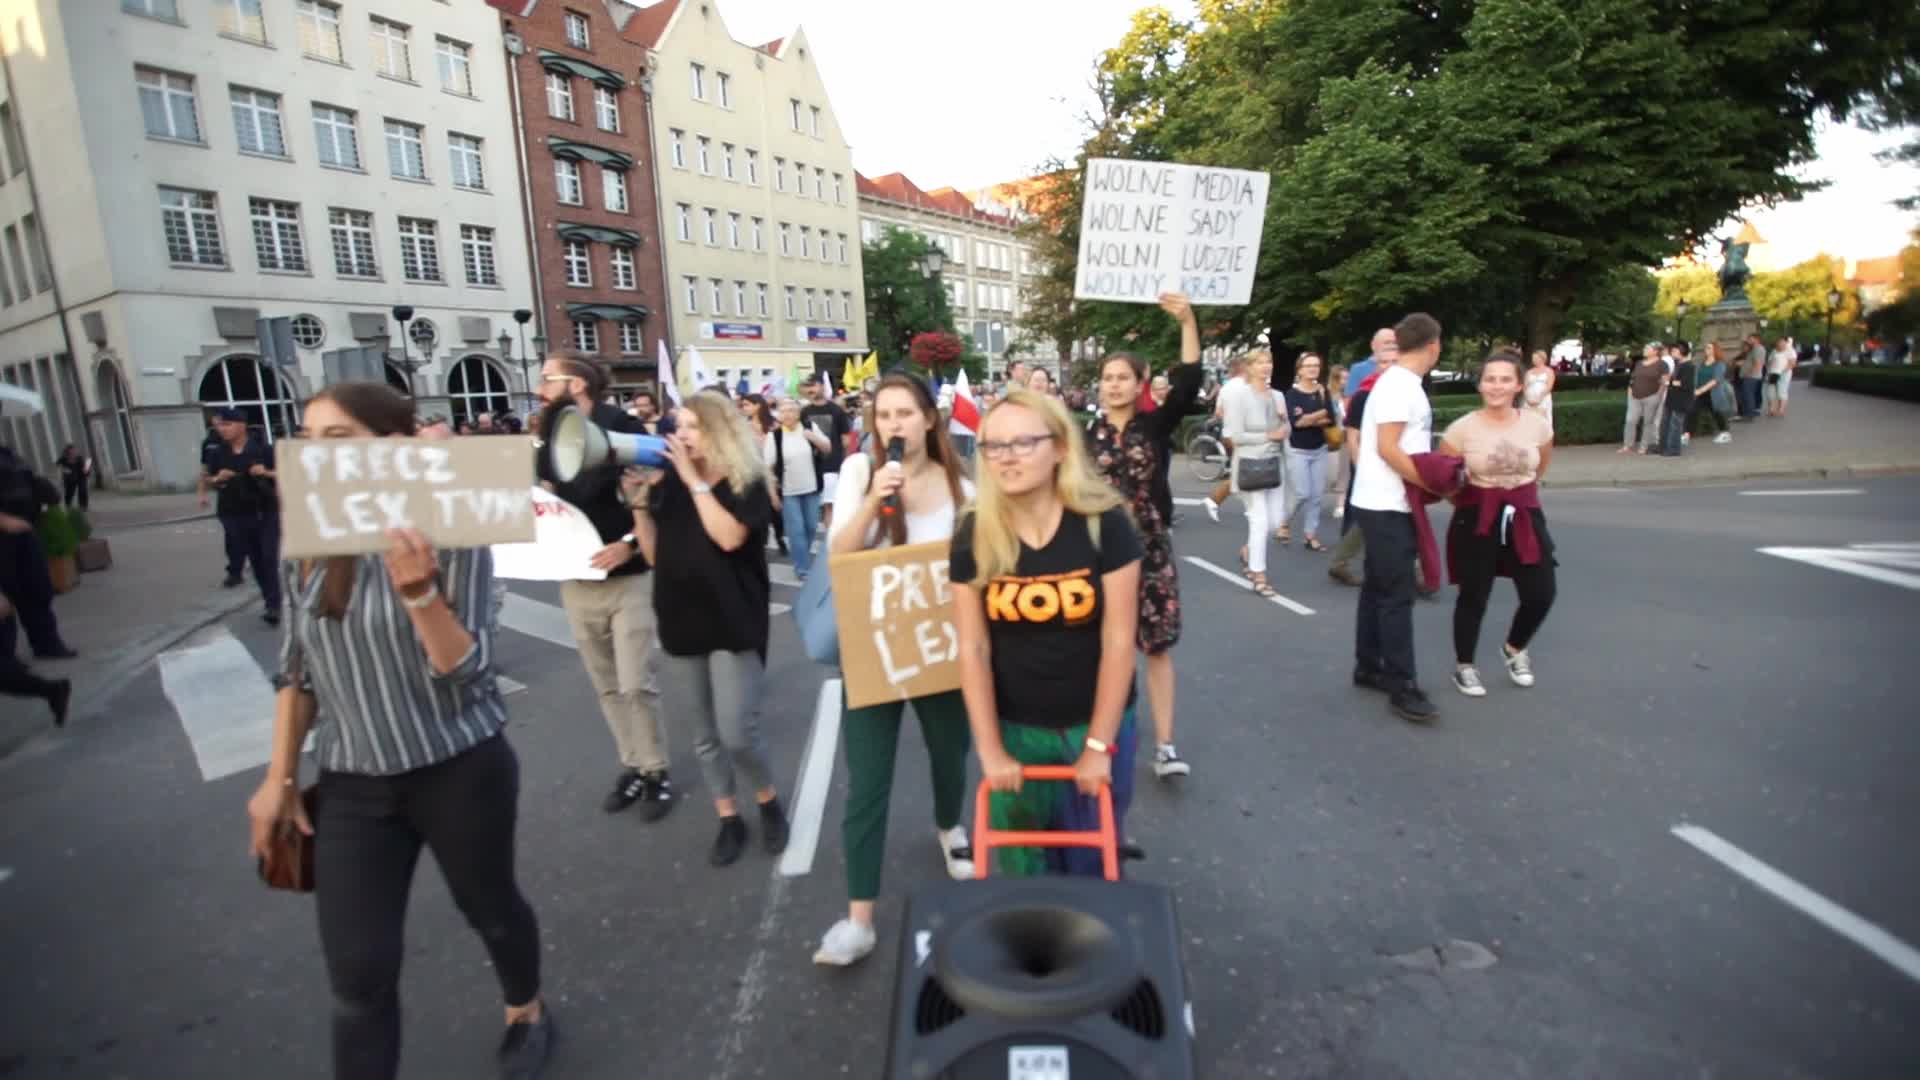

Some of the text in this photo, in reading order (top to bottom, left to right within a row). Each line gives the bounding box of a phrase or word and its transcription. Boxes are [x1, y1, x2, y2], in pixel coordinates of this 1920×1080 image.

[1092, 164, 1255, 204] WOLNE MEDIA
[1089, 203, 1243, 237] WOLNE SADY
[1087, 242, 1248, 272] WOLNI LUDZIE
[1083, 272, 1231, 299] WOLNY KRAJ
[301, 444, 457, 484] PRECZ
[304, 491, 416, 540] LEX
[531, 500, 578, 519] DIA
[870, 558, 951, 622] PRE
[986, 578, 1096, 624] KOD
